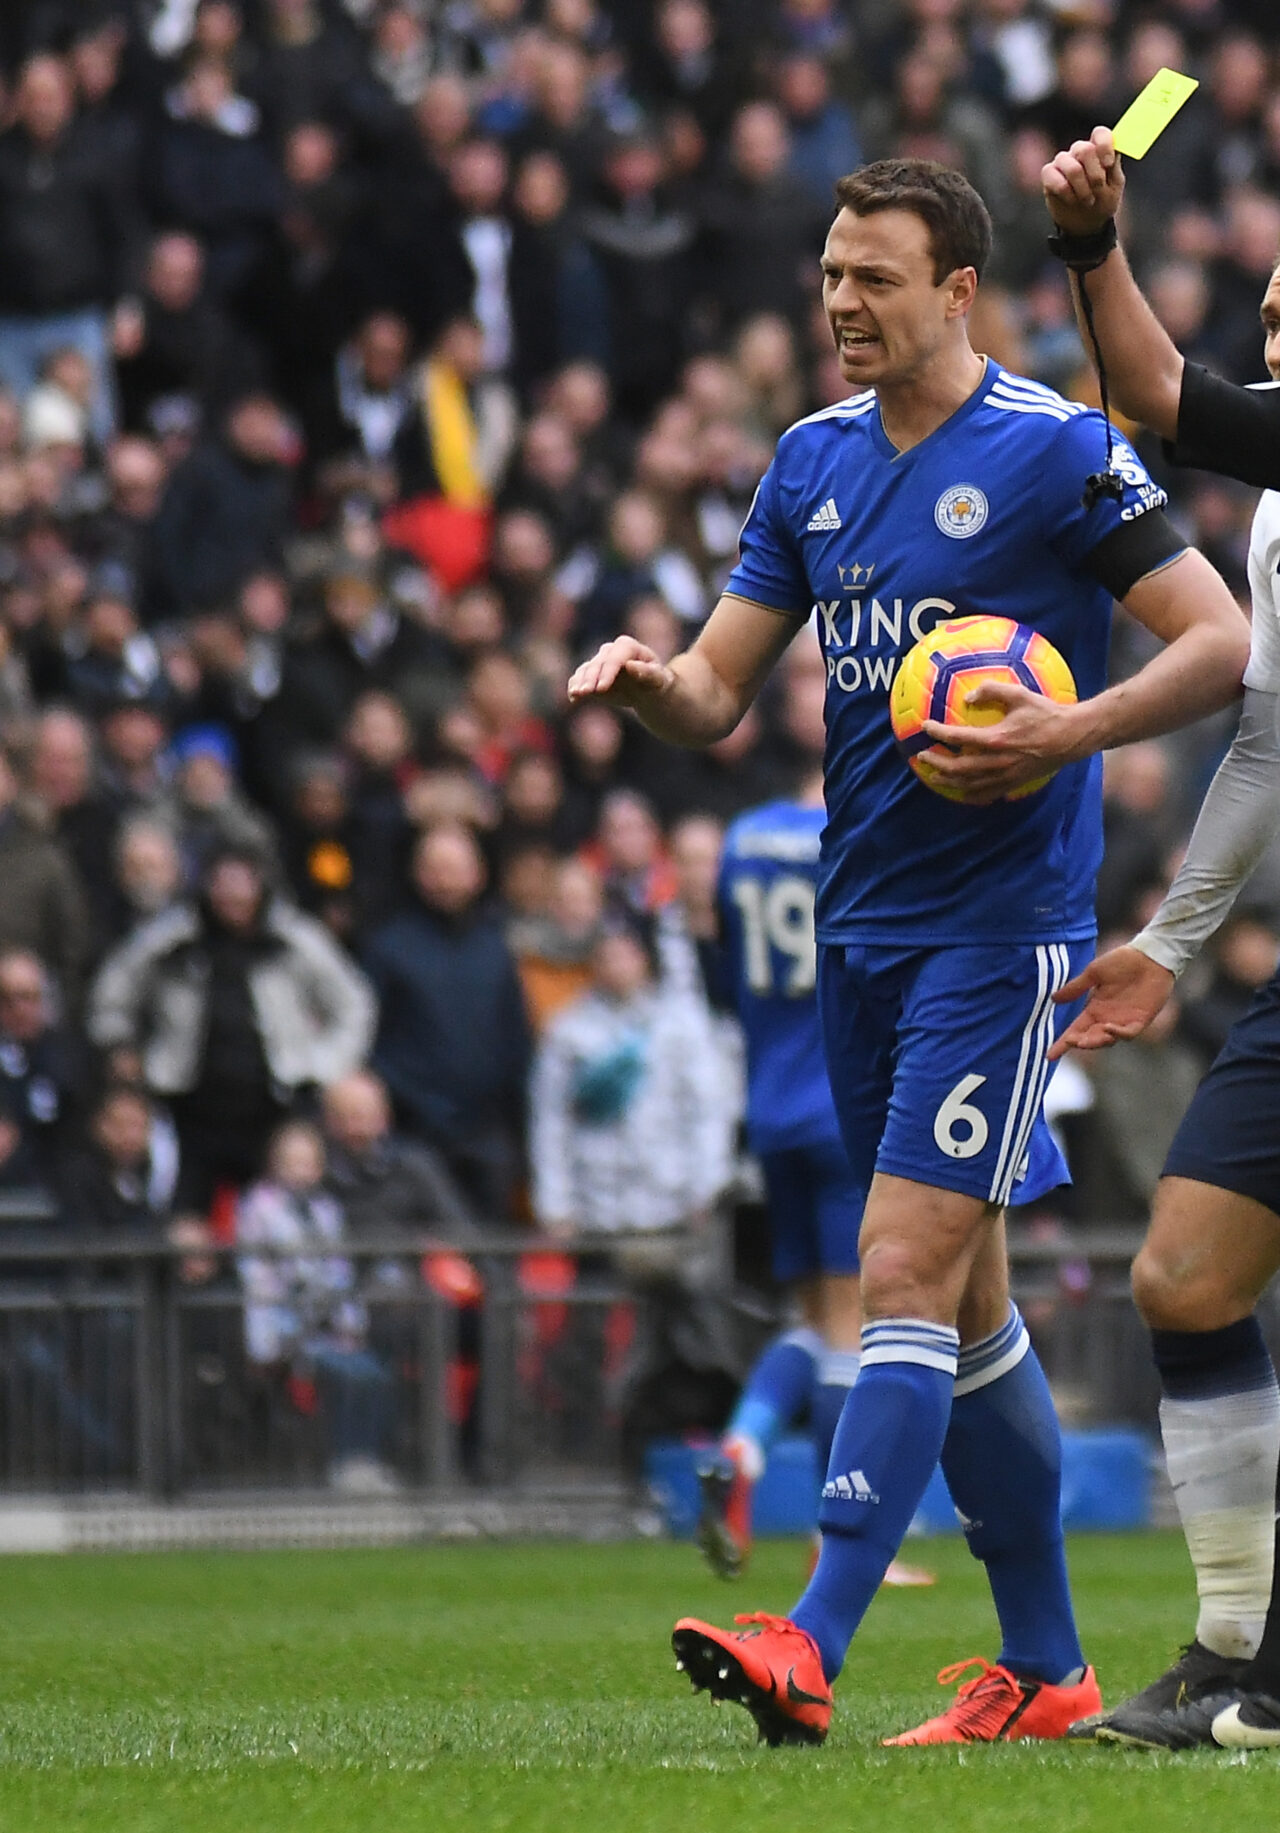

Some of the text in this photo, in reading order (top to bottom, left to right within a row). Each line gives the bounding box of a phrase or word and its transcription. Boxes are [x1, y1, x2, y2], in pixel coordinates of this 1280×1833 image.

[807, 519, 842, 531] adidas
[817, 597, 957, 647] KING
[826, 655, 905, 692] POW
[732, 876, 816, 998] 19
[933, 1072, 989, 1159] 6
